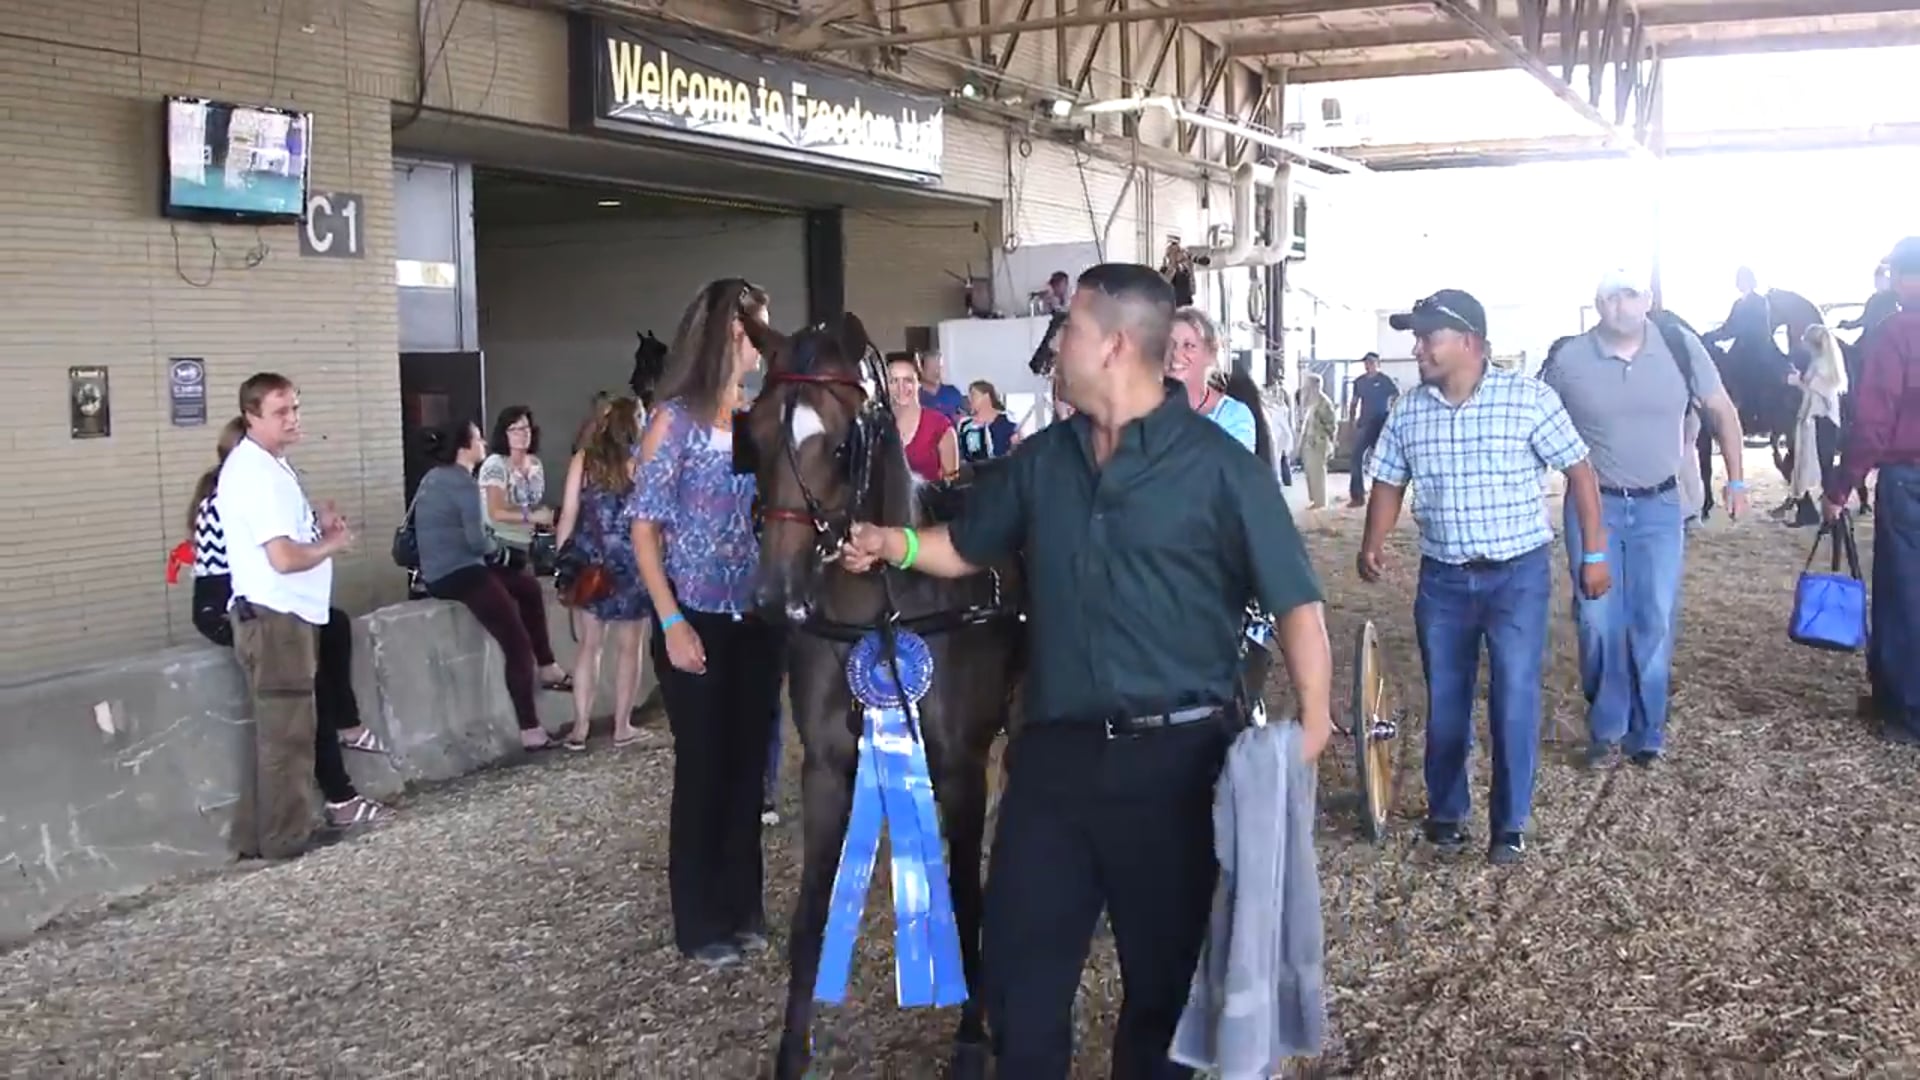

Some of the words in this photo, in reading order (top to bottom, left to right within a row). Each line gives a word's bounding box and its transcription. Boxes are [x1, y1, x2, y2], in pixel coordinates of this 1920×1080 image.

[607, 38, 751, 123] Welcome
[758, 77, 785, 130] to
[792, 82, 898, 147] Freedom
